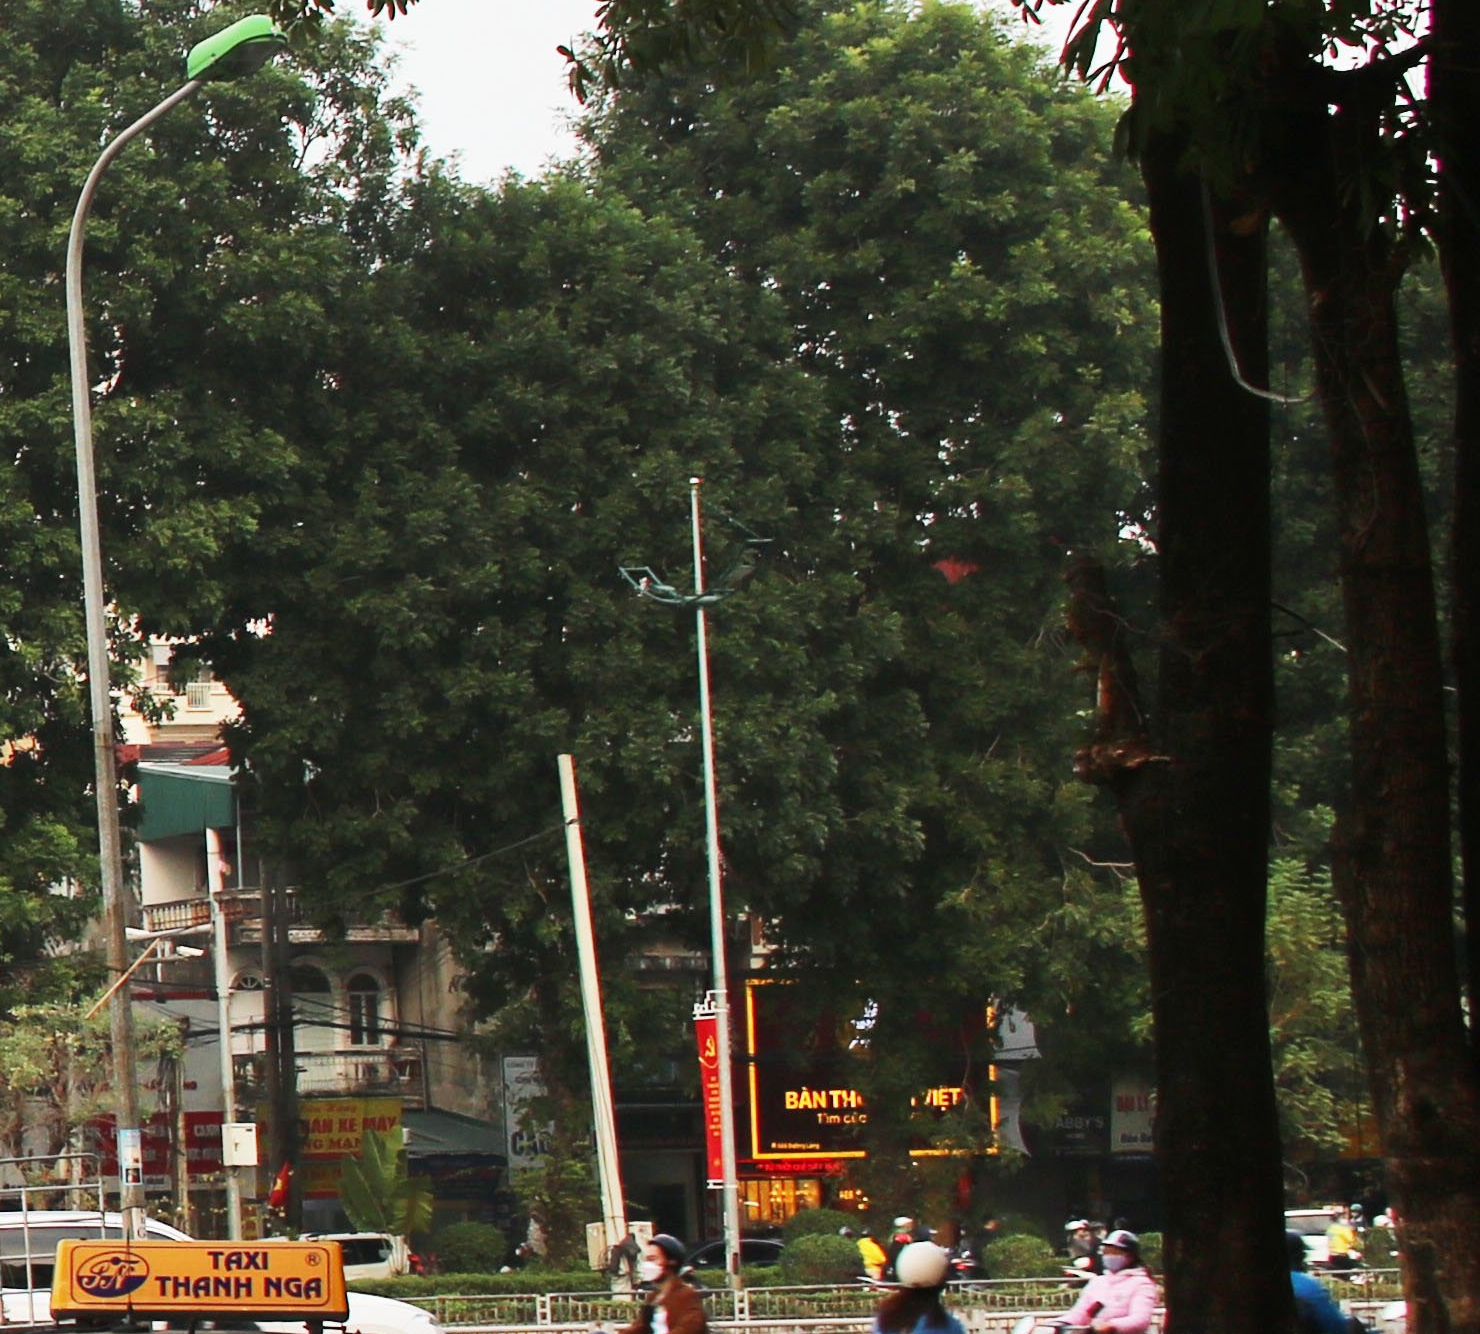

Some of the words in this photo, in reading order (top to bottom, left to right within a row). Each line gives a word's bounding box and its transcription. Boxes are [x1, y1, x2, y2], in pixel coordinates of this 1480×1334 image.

[785, 1086, 827, 1109] BÀN
[207, 1251, 269, 1270] TAXI
[155, 1276, 252, 1299] THANH
[264, 1277, 322, 1299] NGA
